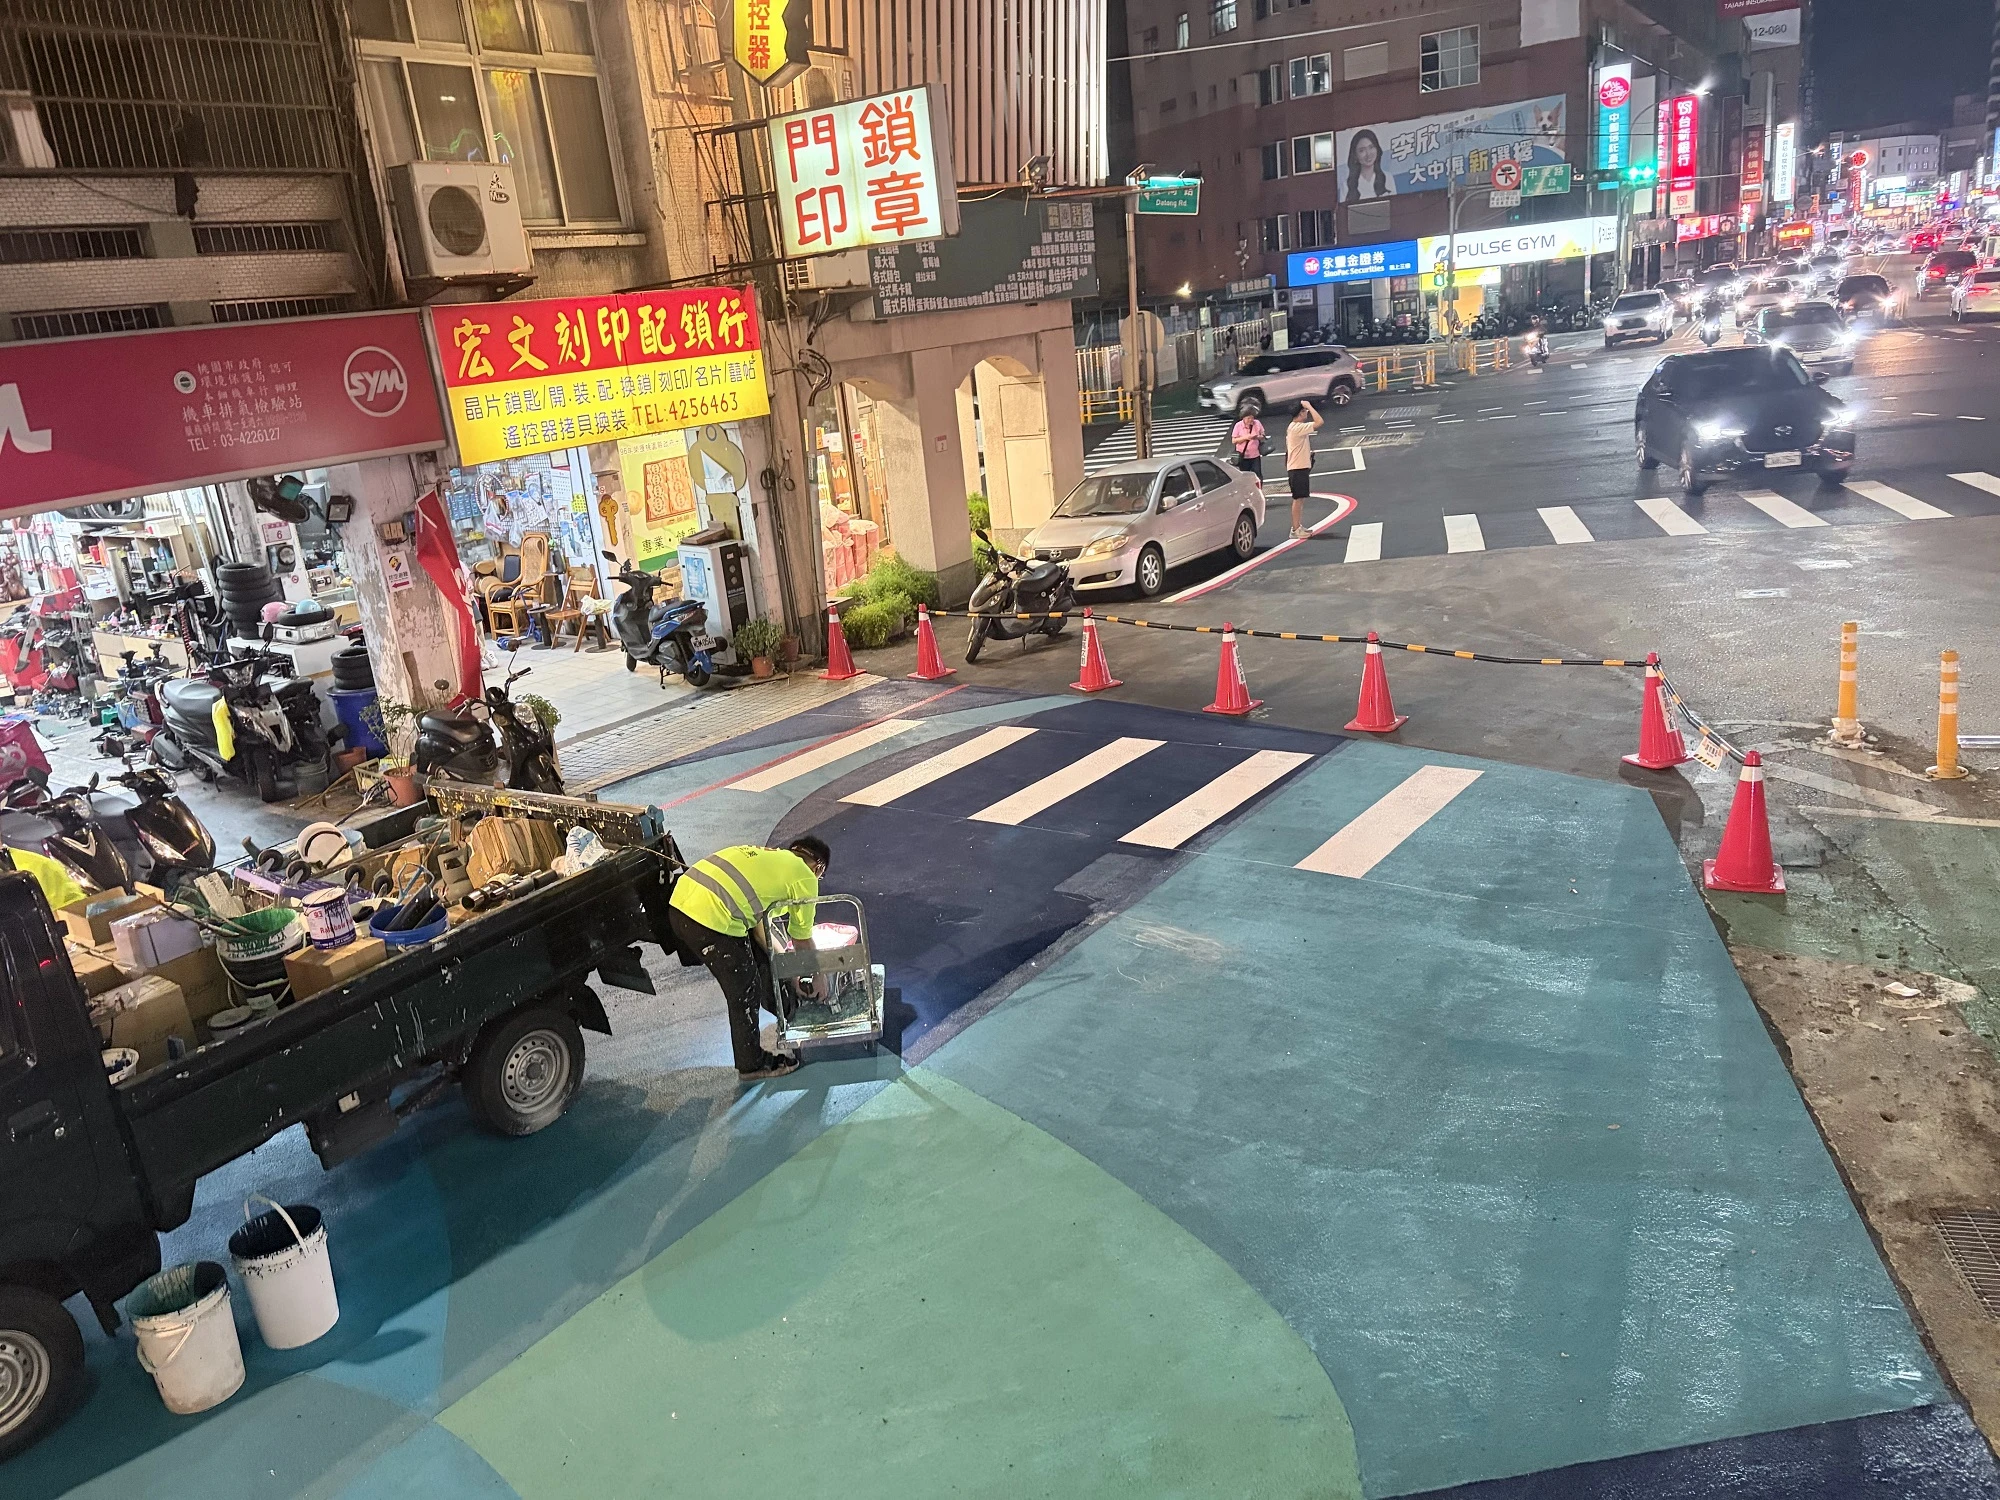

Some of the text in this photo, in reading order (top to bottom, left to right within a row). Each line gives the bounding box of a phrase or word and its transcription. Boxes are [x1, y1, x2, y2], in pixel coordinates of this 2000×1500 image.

[1390, 123, 1441, 162] 李欣
[1677, 115, 1691, 168] 台新銀行
[1155, 199, 1187, 208] Datong Rd
[1456, 234, 1556, 258] PULSE GYM
[1323, 264, 1385, 278] SinoPac Securities
[453, 295, 749, 379] 宏文刻印配鎖行
[349, 368, 405, 402] SYM
[183, 394, 303, 422] 機車排氣檢驗站
[220, 427, 280, 448] 03-4226127
[276, 530, 283, 540] 6
